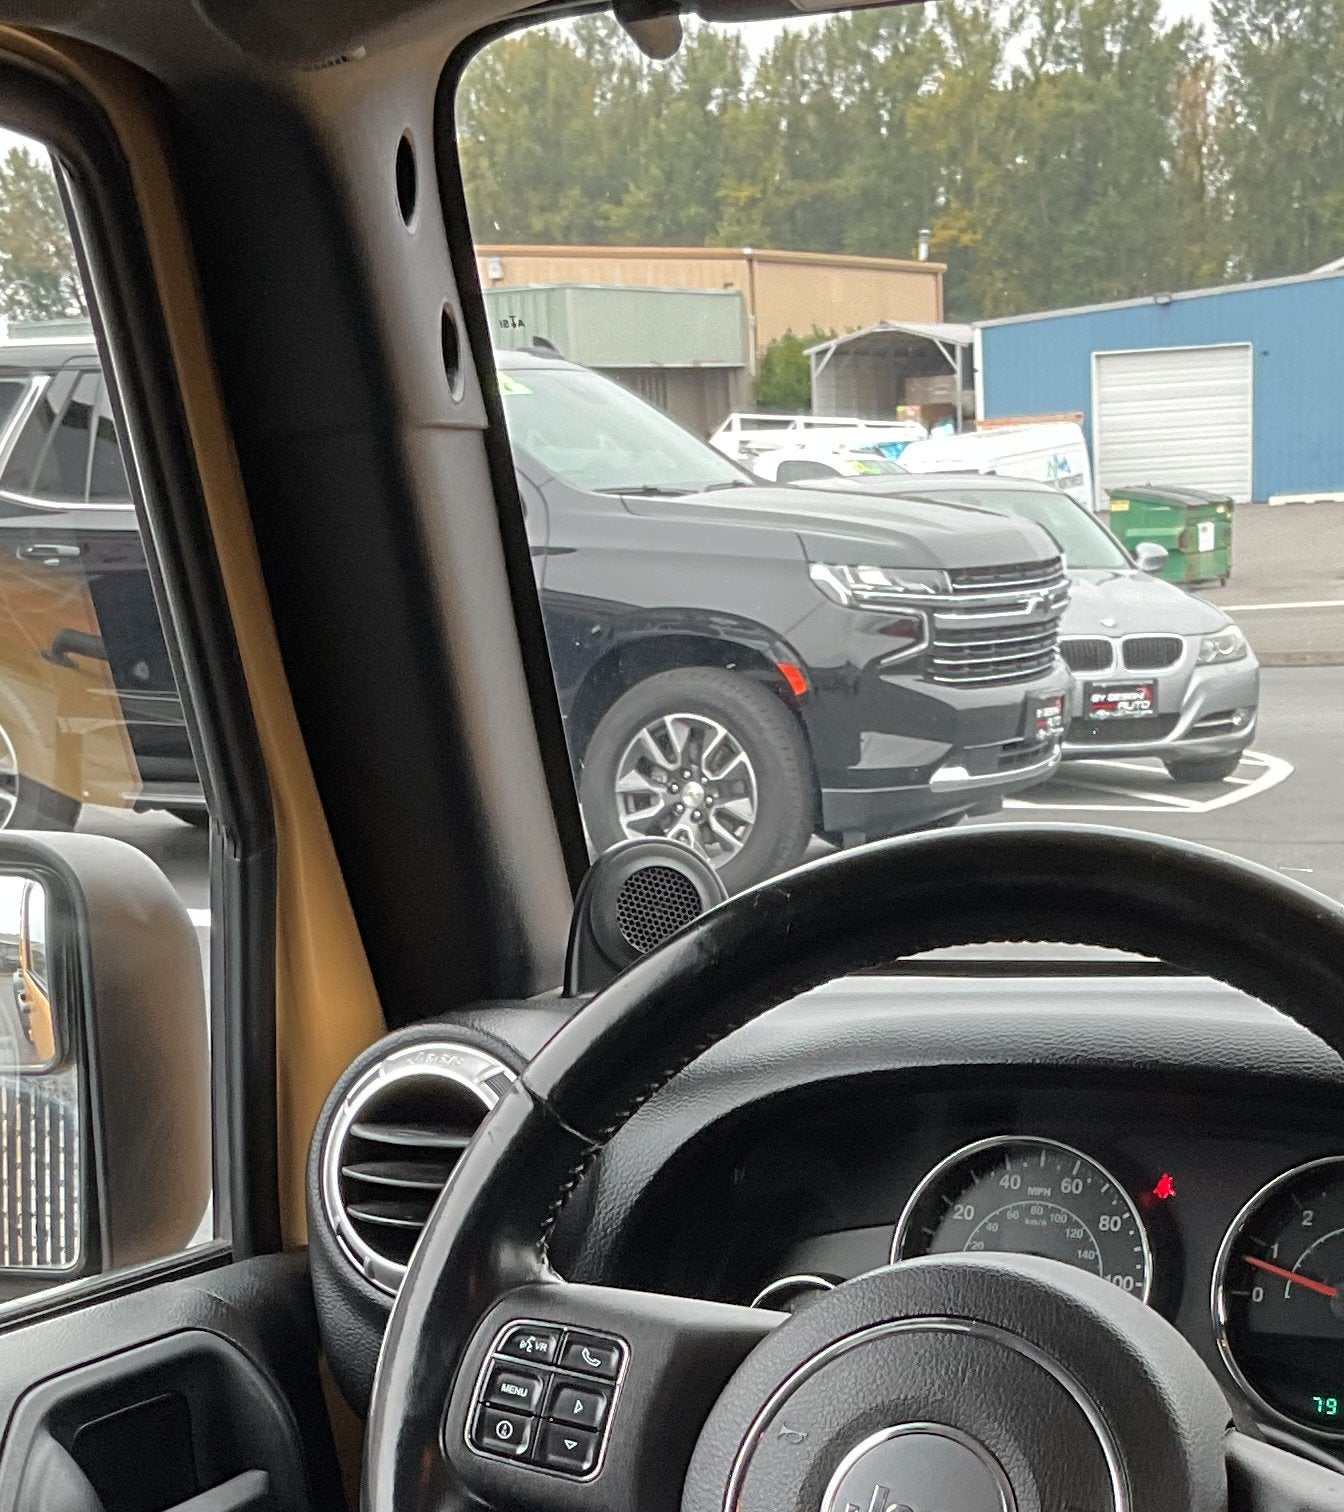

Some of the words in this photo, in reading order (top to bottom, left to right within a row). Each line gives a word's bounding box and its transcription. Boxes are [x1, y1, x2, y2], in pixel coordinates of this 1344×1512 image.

[999, 1174, 1021, 1190] 40
[1061, 1178, 1083, 1194] 60
[1027, 1187, 1051, 1197] MPH
[953, 1205, 975, 1221] 20
[1050, 1213, 1068, 1223] 100
[1302, 1210, 1313, 1225] 2
[986, 1222, 999, 1232] 40
[1098, 1215, 1121, 1232] 80
[1065, 1229, 1084, 1239] 120
[1077, 1250, 1095, 1259] 140
[1272, 1243, 1279, 1258] 1
[1252, 1287, 1264, 1302] 0
[536, 1342, 548, 1352] VR
[501, 1383, 528, 1398] MENU
